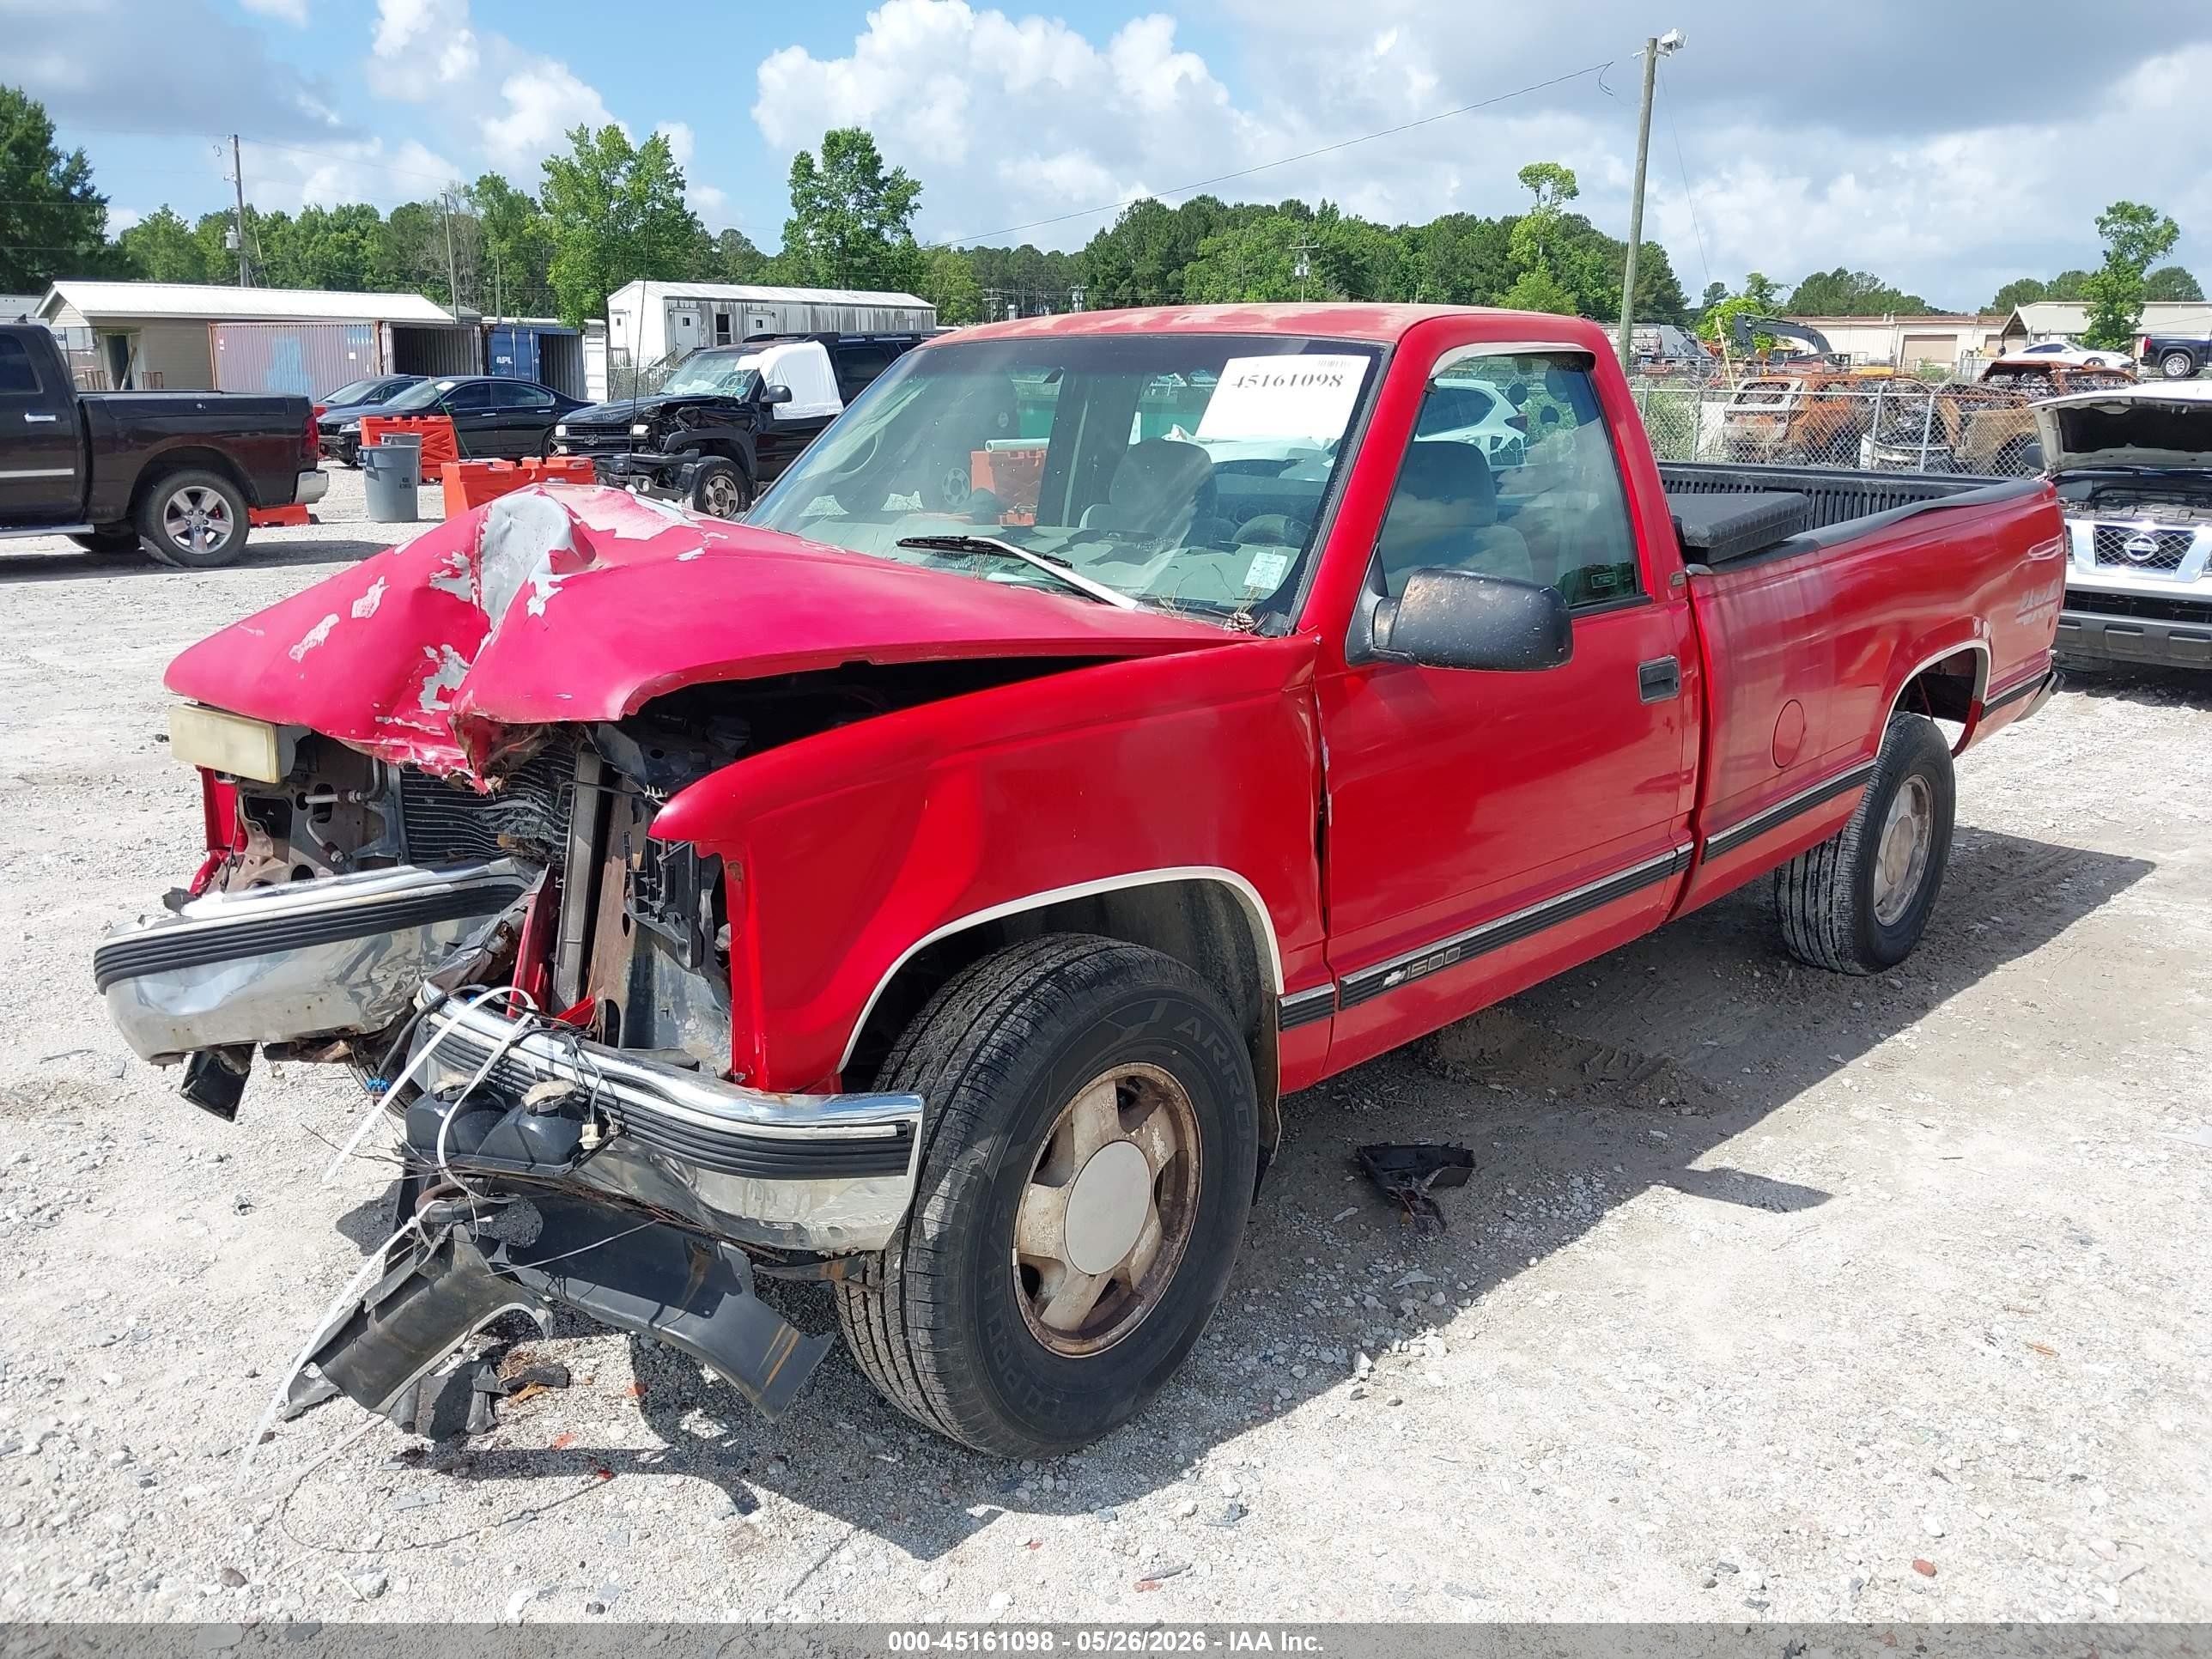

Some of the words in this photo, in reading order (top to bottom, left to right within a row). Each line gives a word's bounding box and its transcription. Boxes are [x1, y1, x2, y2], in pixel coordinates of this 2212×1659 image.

[496, 356, 513, 364] APL
[1231, 374, 1344, 388] 45161098
[1407, 947, 1461, 980] 1500
